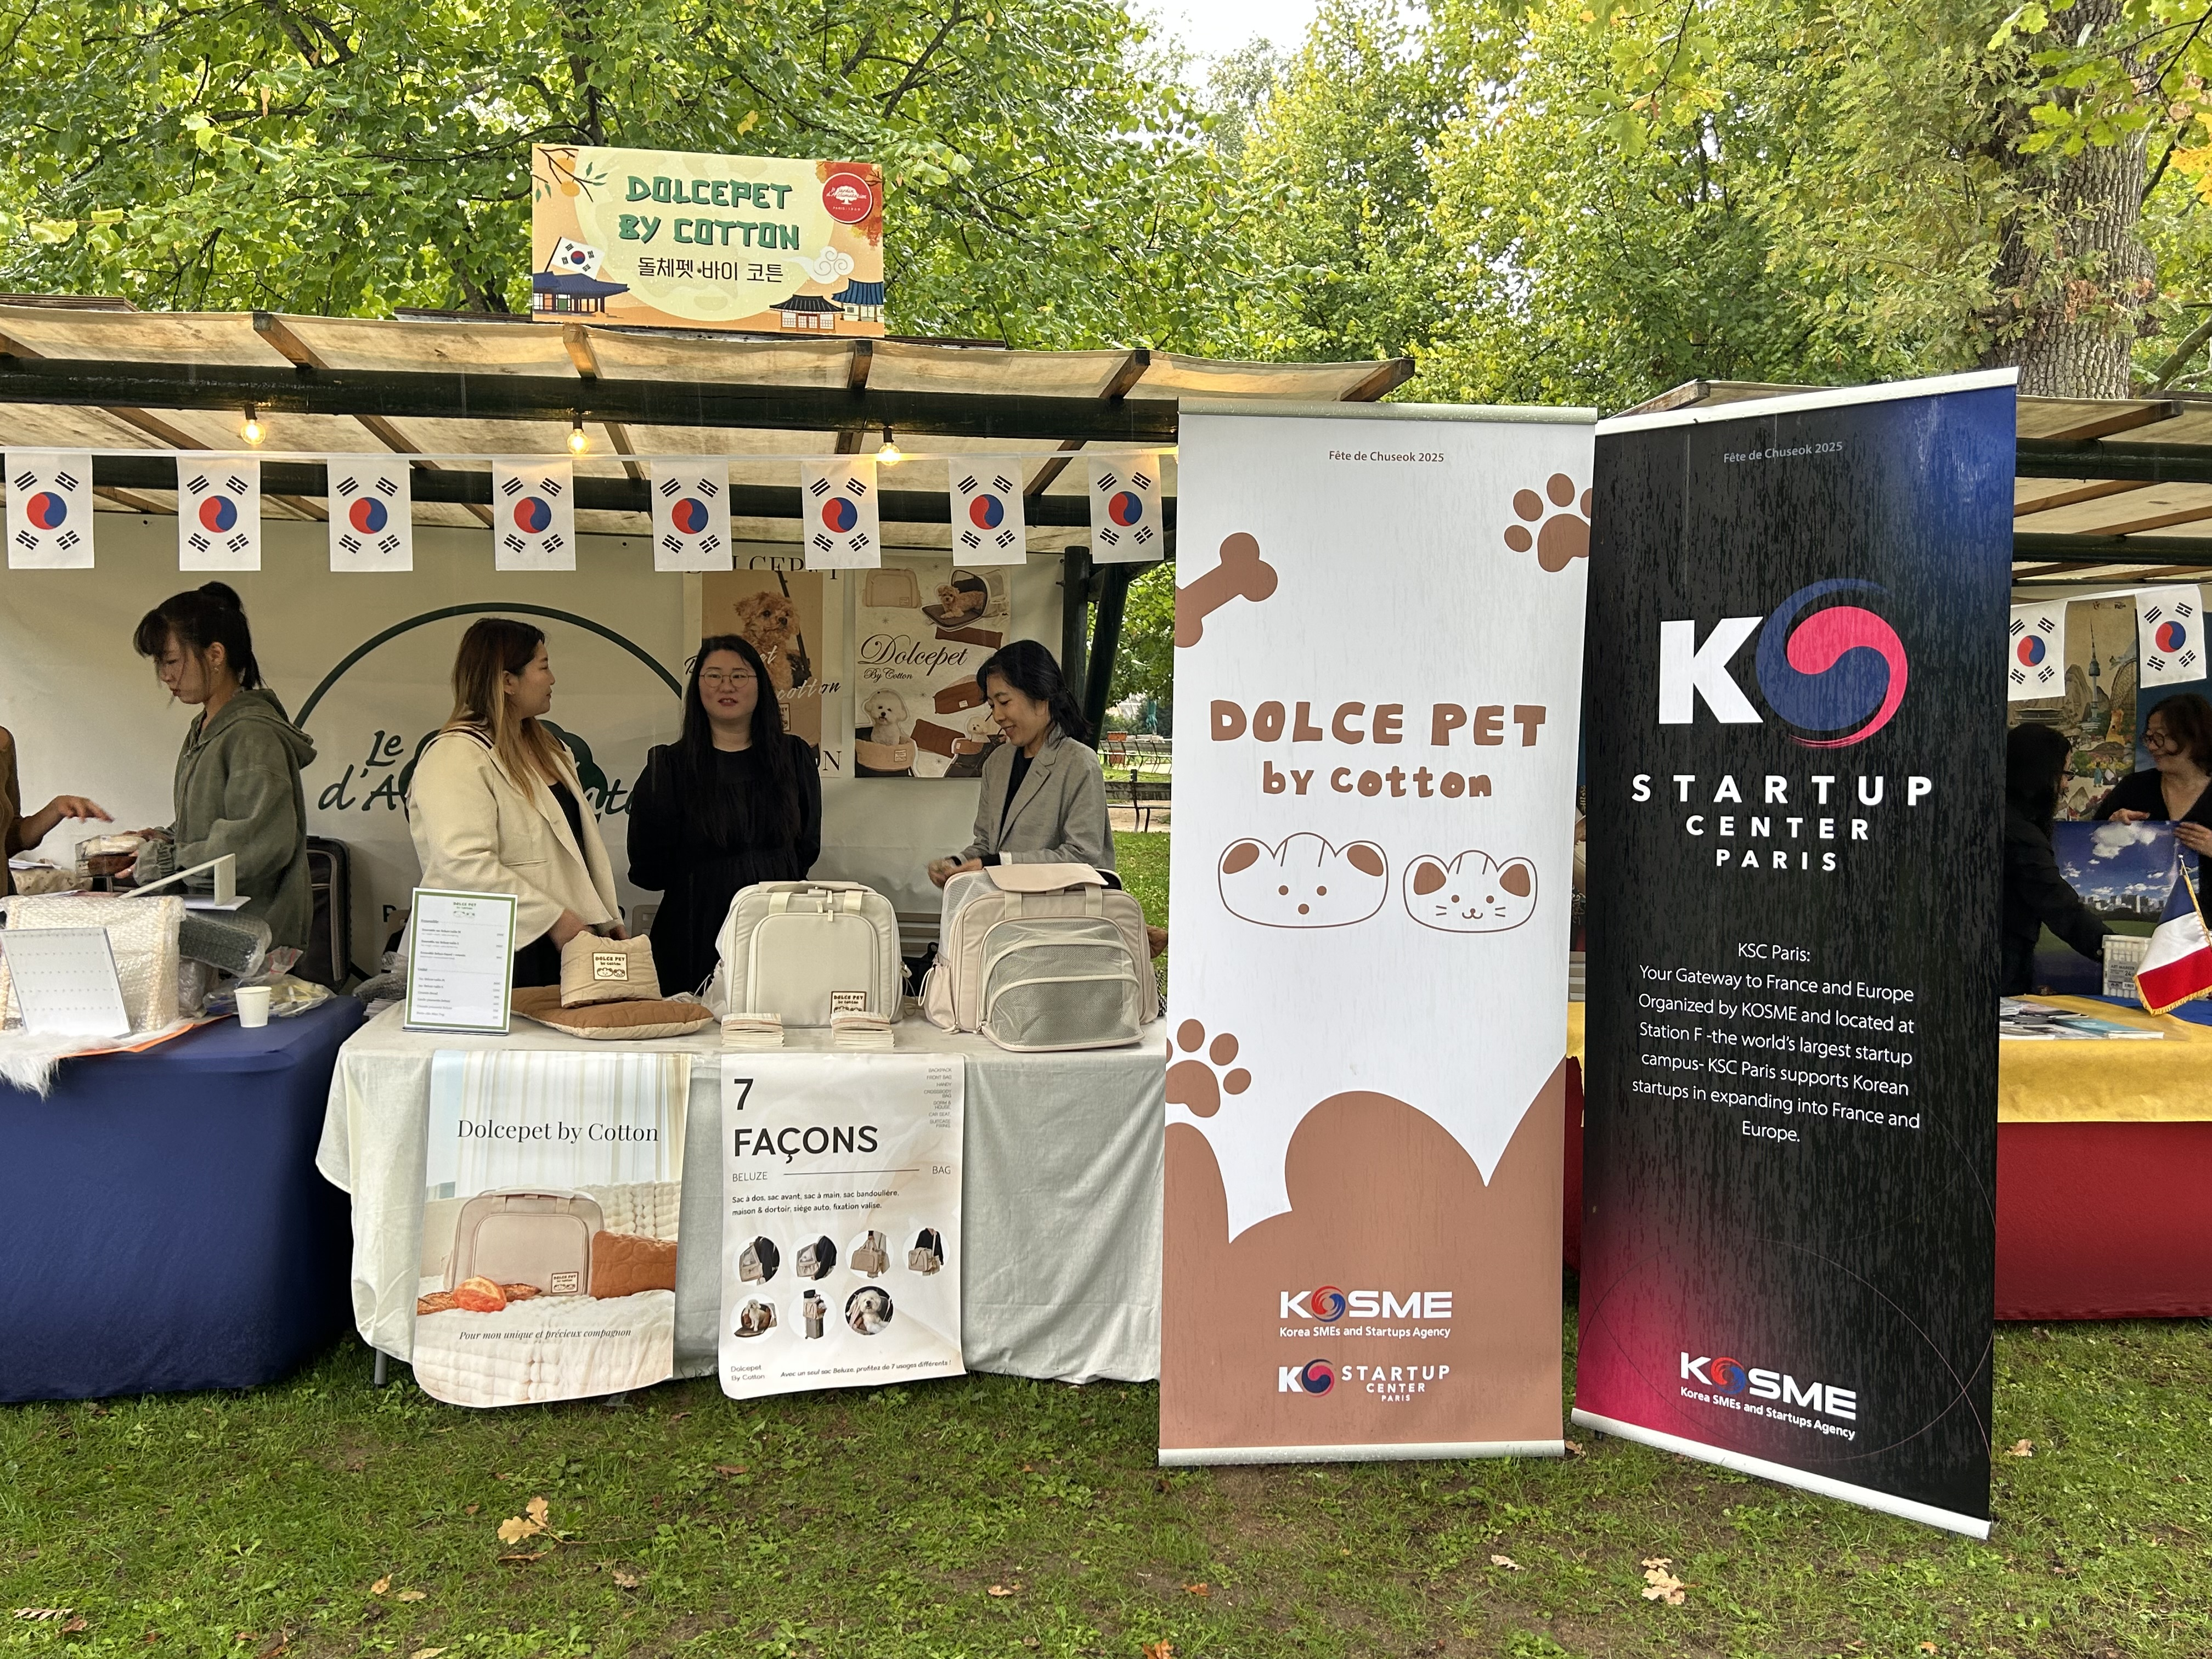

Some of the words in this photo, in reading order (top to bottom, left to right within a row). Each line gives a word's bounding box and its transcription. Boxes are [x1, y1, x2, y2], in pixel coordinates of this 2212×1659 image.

[625, 176, 792, 209] DOLCEPET
[618, 215, 661, 243] BY
[673, 218, 799, 250] COTTON
[638, 257, 694, 278] 돌체펫
[747, 263, 783, 283] 코튼
[1329, 450, 1352, 460] Fête
[1354, 451, 1367, 461] de
[1370, 452, 1415, 461] Chuseok
[1418, 453, 1444, 462] 2025
[1723, 451, 1746, 463] Fête
[1748, 449, 1762, 460] de
[1765, 445, 1812, 459] Chuseok
[1815, 442, 1843, 454] 2025
[857, 634, 968, 676] Dolcepet
[864, 668, 882, 683] By
[883, 668, 913, 680] Cotton
[1211, 699, 1403, 744] DOLCE
[1430, 703, 1547, 747] PET
[366, 730, 404, 766] Le
[1632, 774, 1932, 806] STARTUP
[1686, 815, 1869, 840] CENTER
[1716, 849, 1837, 871] PARIS
[1739, 943, 1768, 959] KSC
[1772, 945, 1810, 962] Paris:
[1639, 965, 1672, 982] Your
[1675, 968, 1742, 990] Gateway
[1746, 974, 1762, 989] to
[1767, 975, 1818, 993] France
[1822, 980, 1852, 996] and
[1857, 982, 1914, 1005] Europe
[1639, 994, 1714, 1014] Organized
[1719, 1000, 1737, 1019] by
[1742, 1002, 1797, 1022] KOSME
[1801, 1008, 1831, 1025] and
[1836, 1011, 1893, 1031] located
[1898, 1018, 1914, 1034] at
[1640, 1022, 1690, 1041] Station
[1694, 1027, 1703, 1042] F
[1741, 1034, 1796, 1052] world’s
[1800, 1037, 1851, 1058] largest
[1855, 1045, 1912, 1068] startup
[1641, 1053, 1704, 1071] campus-
[1708, 1058, 1737, 1075] KSC
[1742, 1062, 1776, 1079] Paris
[1780, 1067, 1849, 1088] supports
[1853, 1075, 1909, 1096] Korean
[733, 1078, 753, 1110] 7
[1633, 1079, 1689, 1100] startups
[1693, 1085, 1706, 1100] in
[1711, 1091, 1793, 1114] expanding
[1798, 1098, 1827, 1115] into
[1832, 1102, 1884, 1124] France
[1888, 1113, 1920, 1129] and
[457, 1119, 552, 1143] Dolcepet
[558, 1122, 583, 1144] by
[588, 1123, 658, 1142] Cotton
[1742, 1120, 1801, 1143] Europe.
[734, 1125, 878, 1164] FAÇONS
[732, 1171, 768, 1182] BELUZE
[932, 1165, 951, 1175] BAG
[823, 1191, 842, 1199] main,
[732, 1207, 755, 1216] maison
[765, 1205, 792, 1214] dortoir,
[793, 1204, 812, 1214] siège
[833, 1202, 859, 1210] fixation
[459, 1331, 481, 1340] Pour
[504, 1330, 533, 1340] unique
[535, 1330, 543, 1339] et
[545, 1328, 582, 1340] précieux
[583, 1329, 631, 1339] compagnon
[1279, 1327, 1311, 1338] Korea
[1313, 1326, 1341, 1336] SMEs
[1344, 1326, 1362, 1336] and
[1365, 1326, 1410, 1339] Startups
[1412, 1327, 1451, 1339] Agency
[856, 1365, 881, 1374] profitez
[1341, 1365, 1450, 1381] STARTUP
[1366, 1383, 1425, 1393] CENTER
[1680, 1386, 1710, 1403] Korea
[1713, 1394, 1741, 1410] SMEs
[1743, 1402, 1764, 1415] and
[1766, 1407, 1812, 1428] Startups
[1813, 1419, 1855, 1441] Agency
